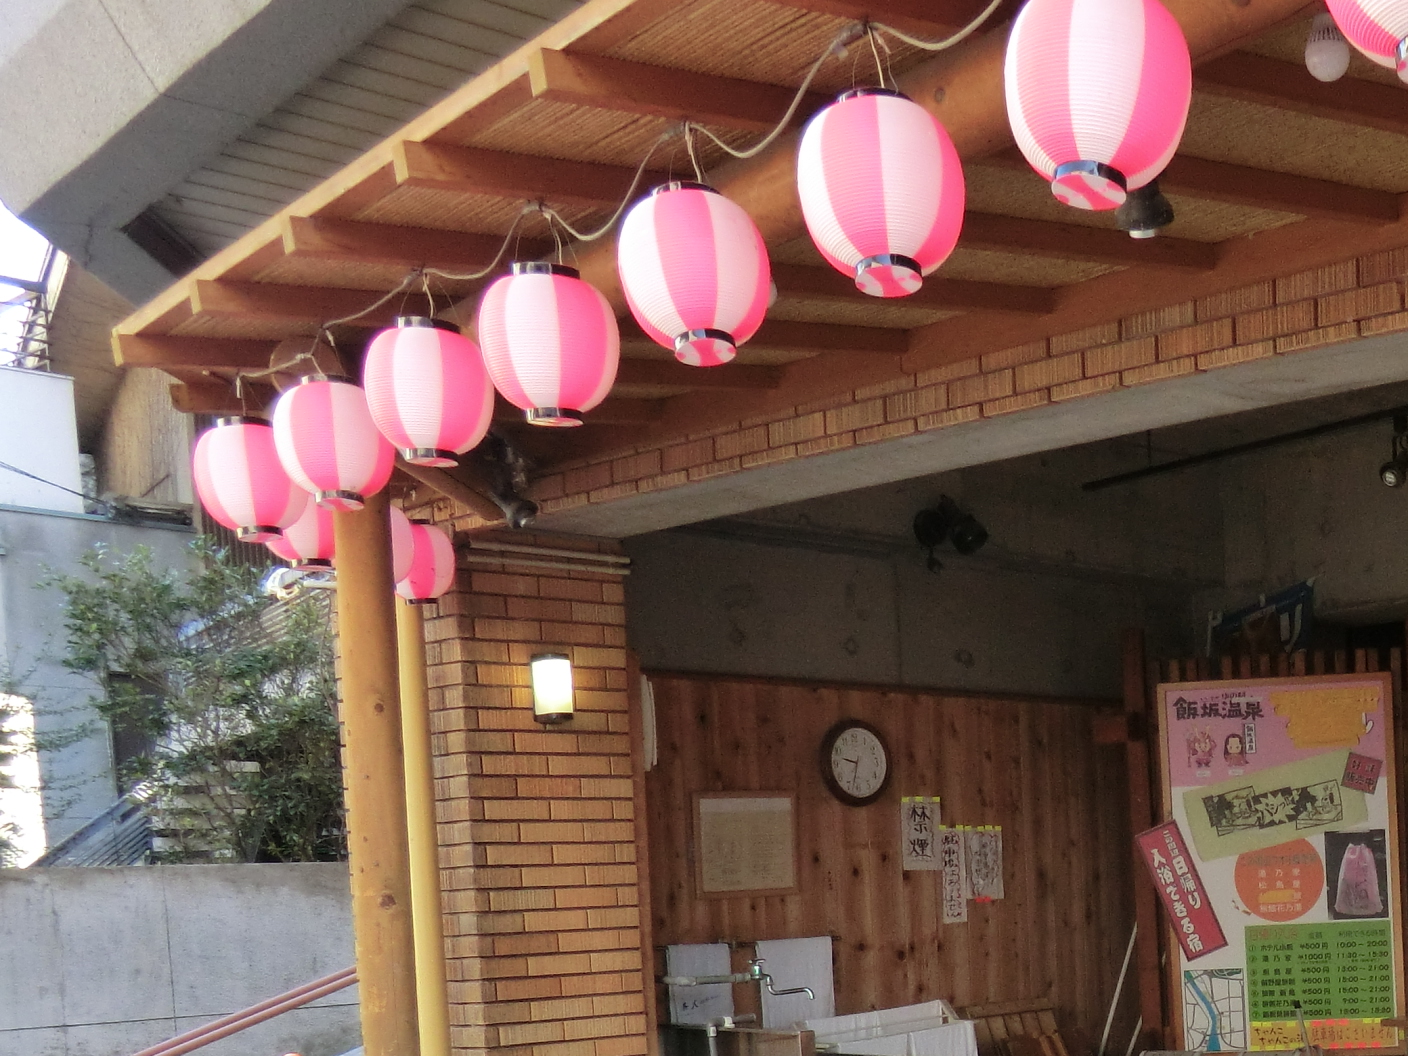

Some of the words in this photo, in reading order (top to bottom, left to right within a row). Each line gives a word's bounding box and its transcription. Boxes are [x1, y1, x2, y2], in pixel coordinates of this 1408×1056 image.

[1173, 696, 1264, 720] 飯坂温泉
[910, 804, 932, 858] 禁煙
[1150, 848, 1204, 953] 入浴できる宿
[1254, 1027, 1283, 1036] ちゃんこ
